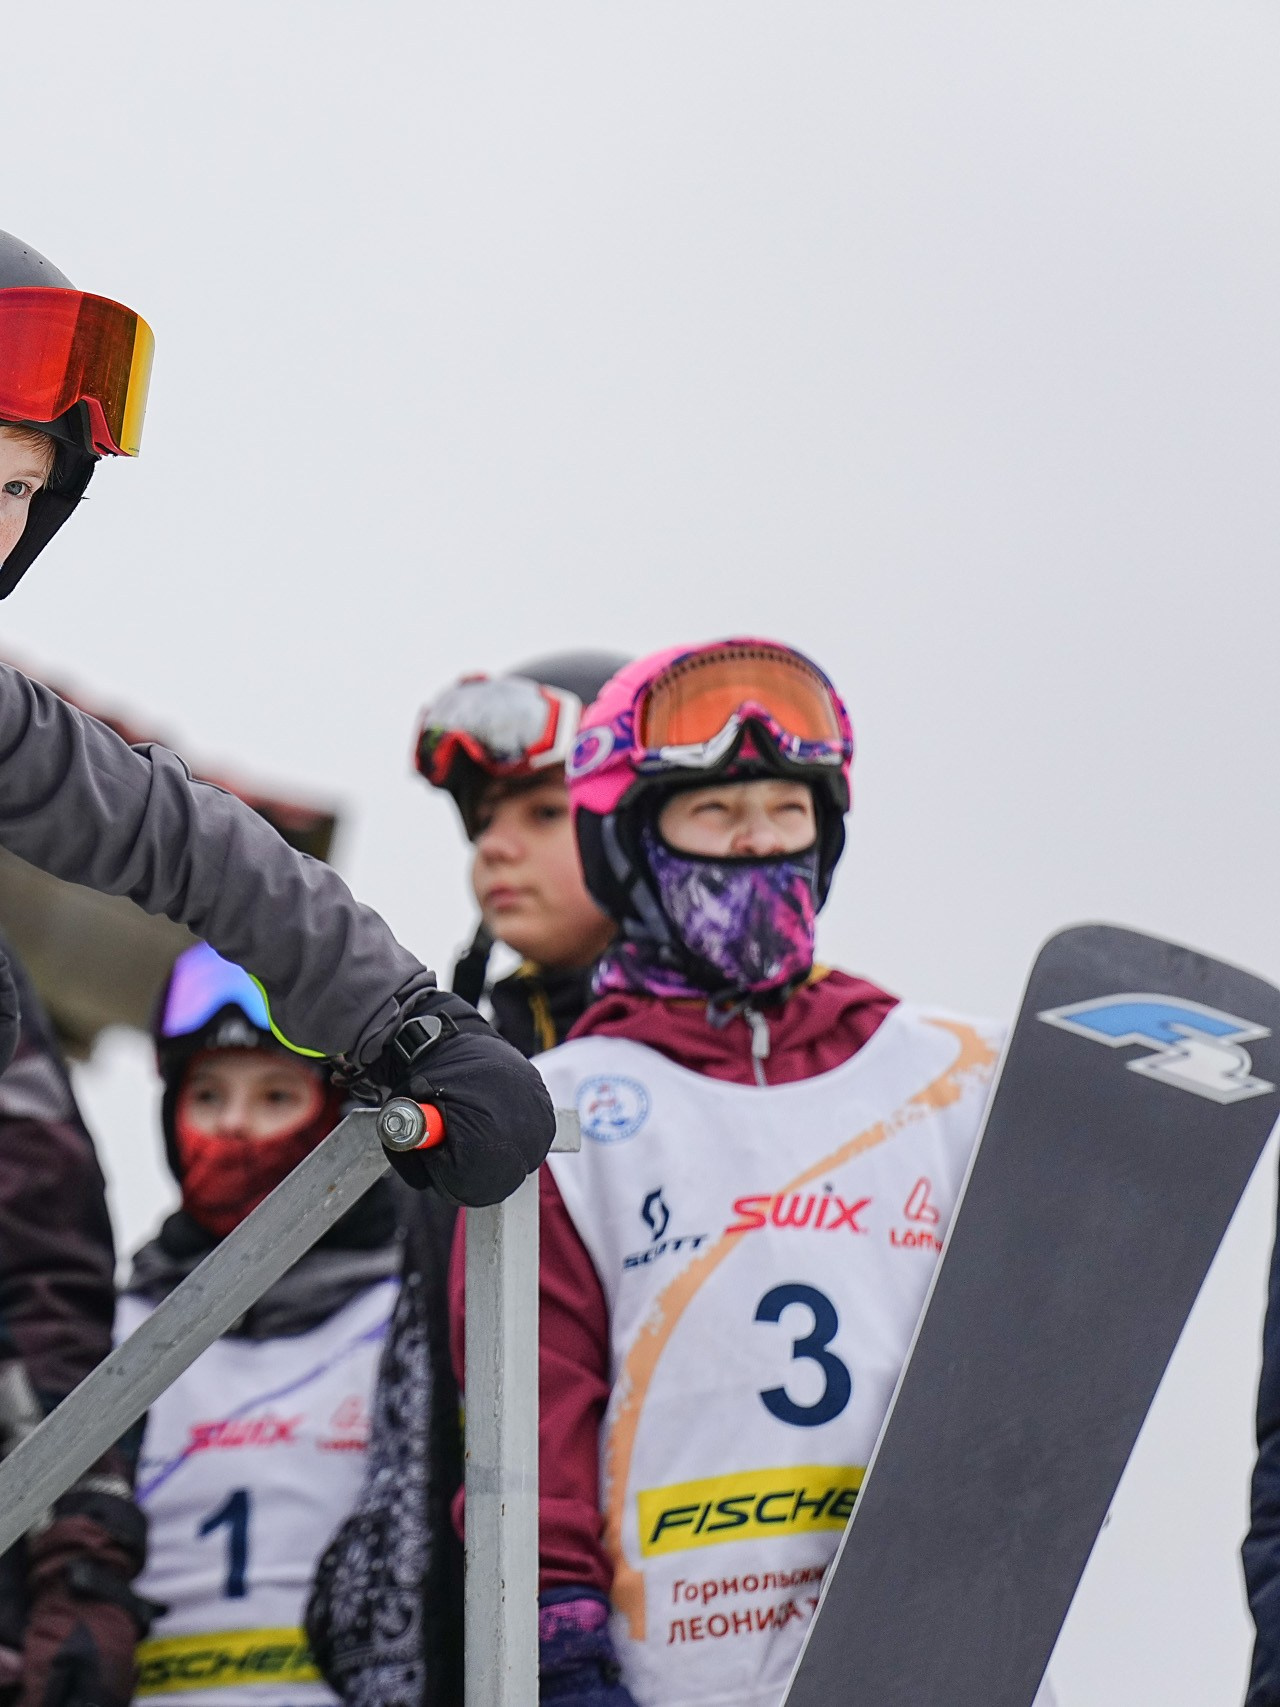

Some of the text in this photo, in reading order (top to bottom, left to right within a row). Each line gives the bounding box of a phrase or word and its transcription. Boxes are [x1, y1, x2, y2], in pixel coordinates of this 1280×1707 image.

[753, 1282, 853, 1428] 3
[196, 1487, 254, 1599] 1
[649, 1486, 860, 1545] FISCHE
